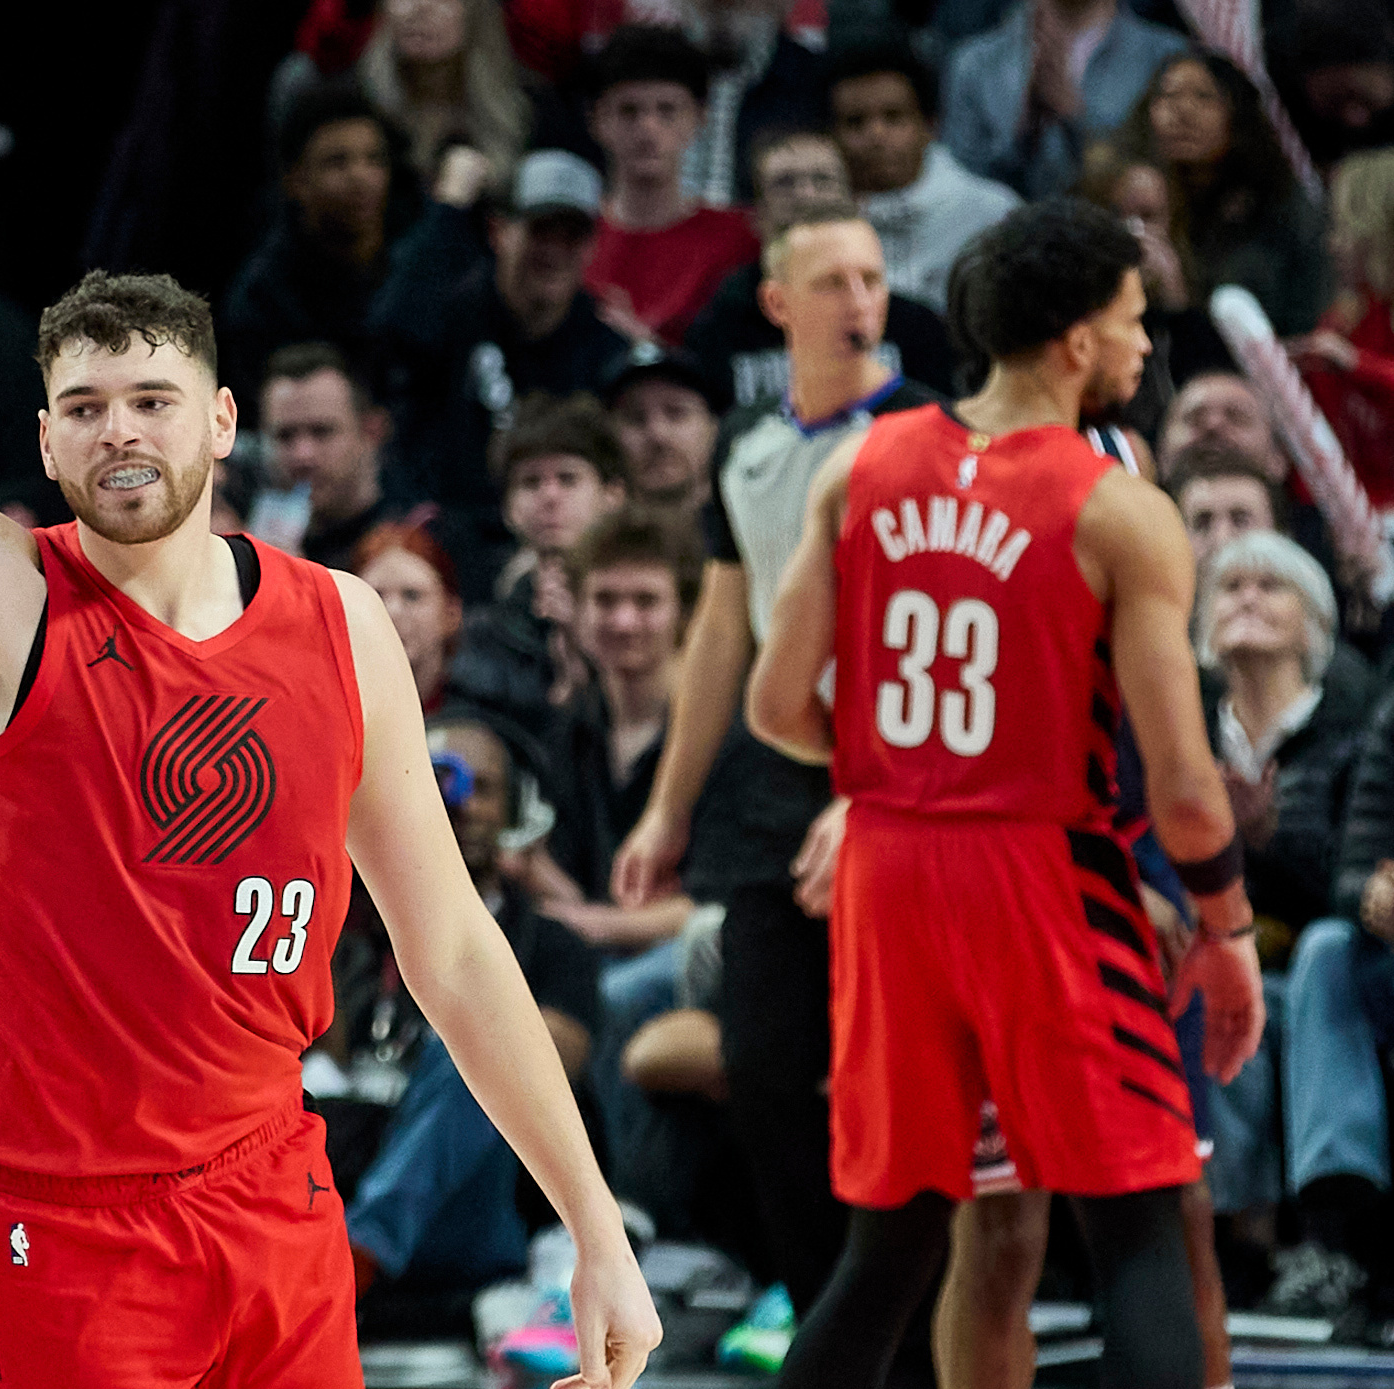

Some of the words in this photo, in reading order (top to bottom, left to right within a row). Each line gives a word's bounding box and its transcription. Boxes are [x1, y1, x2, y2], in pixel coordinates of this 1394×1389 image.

[871, 495, 1032, 582] CAMARA
[876, 587, 1000, 758] 33
[231, 875, 316, 974] 23
